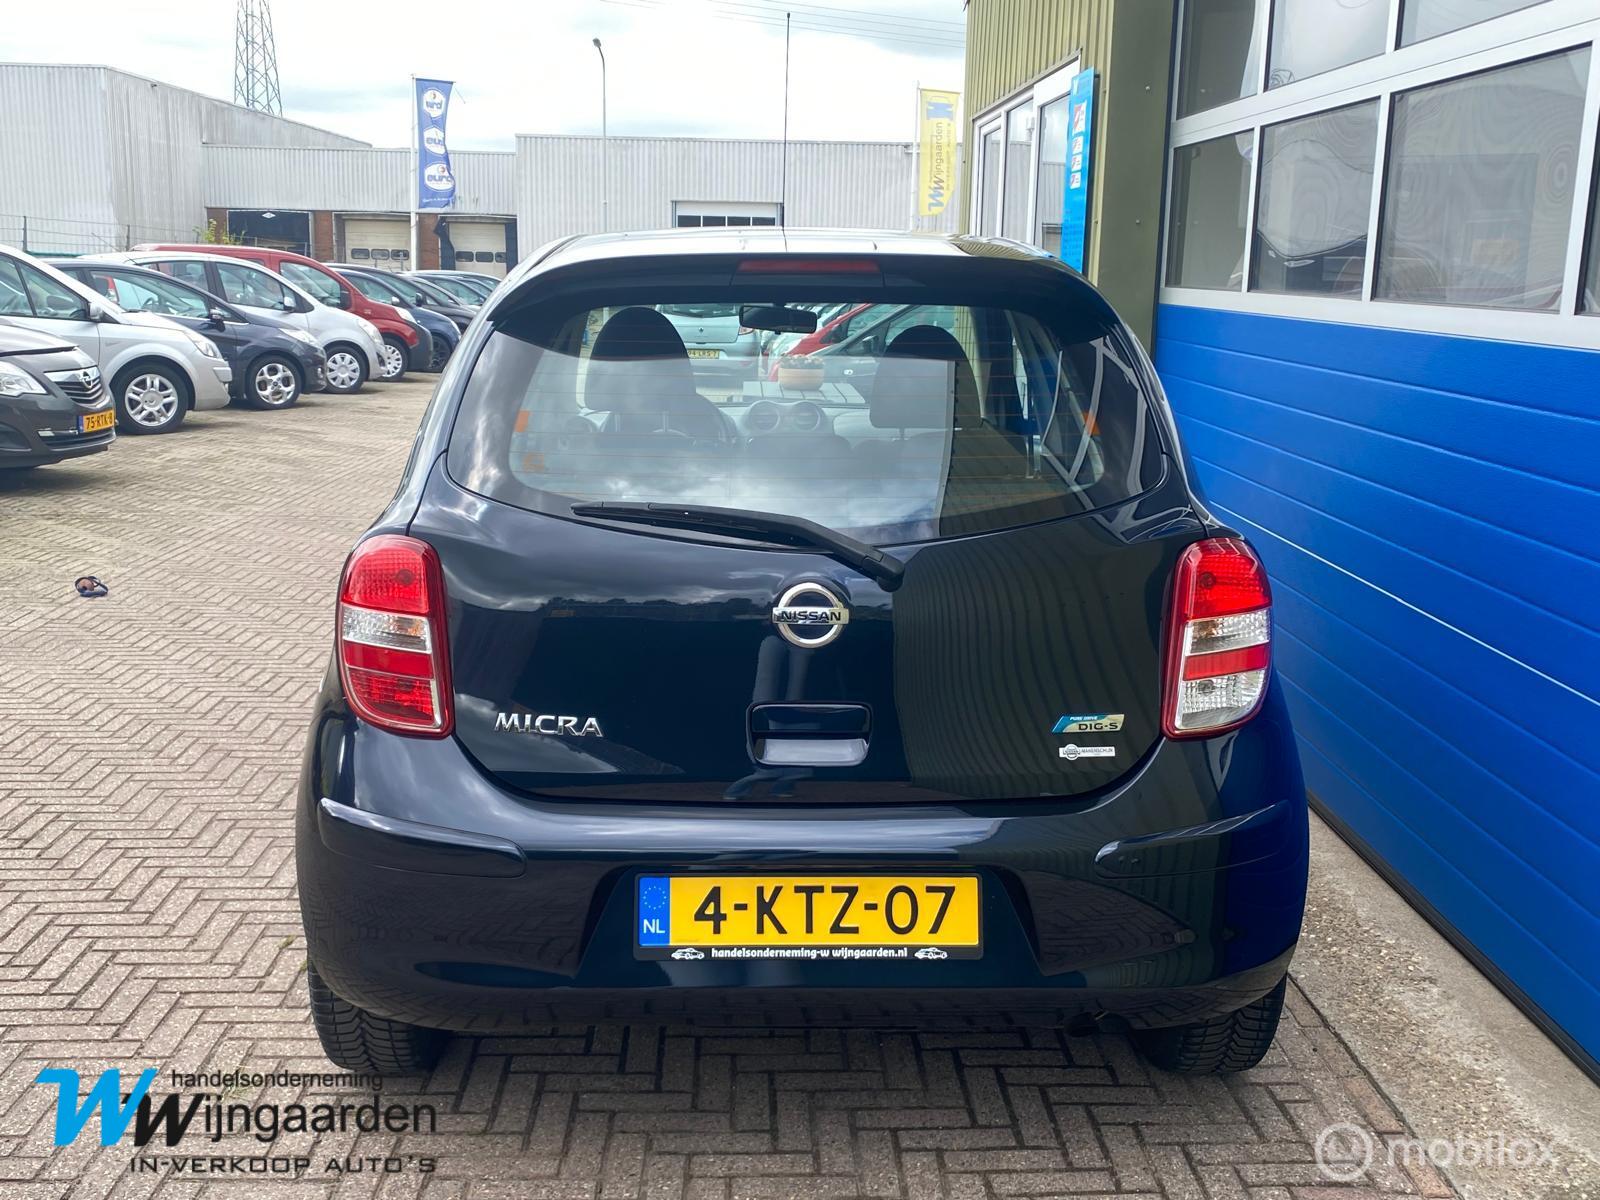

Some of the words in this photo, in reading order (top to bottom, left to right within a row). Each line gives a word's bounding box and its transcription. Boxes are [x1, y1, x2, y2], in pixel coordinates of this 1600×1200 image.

[781, 611, 841, 621] NISSAN
[494, 713, 604, 737] MICRA
[1079, 723, 1118, 731] DIG-S
[643, 919, 666, 934] NL
[694, 885, 956, 935] 4-KTZ-07
[832, 947, 908, 959] wijngaarden.nl
